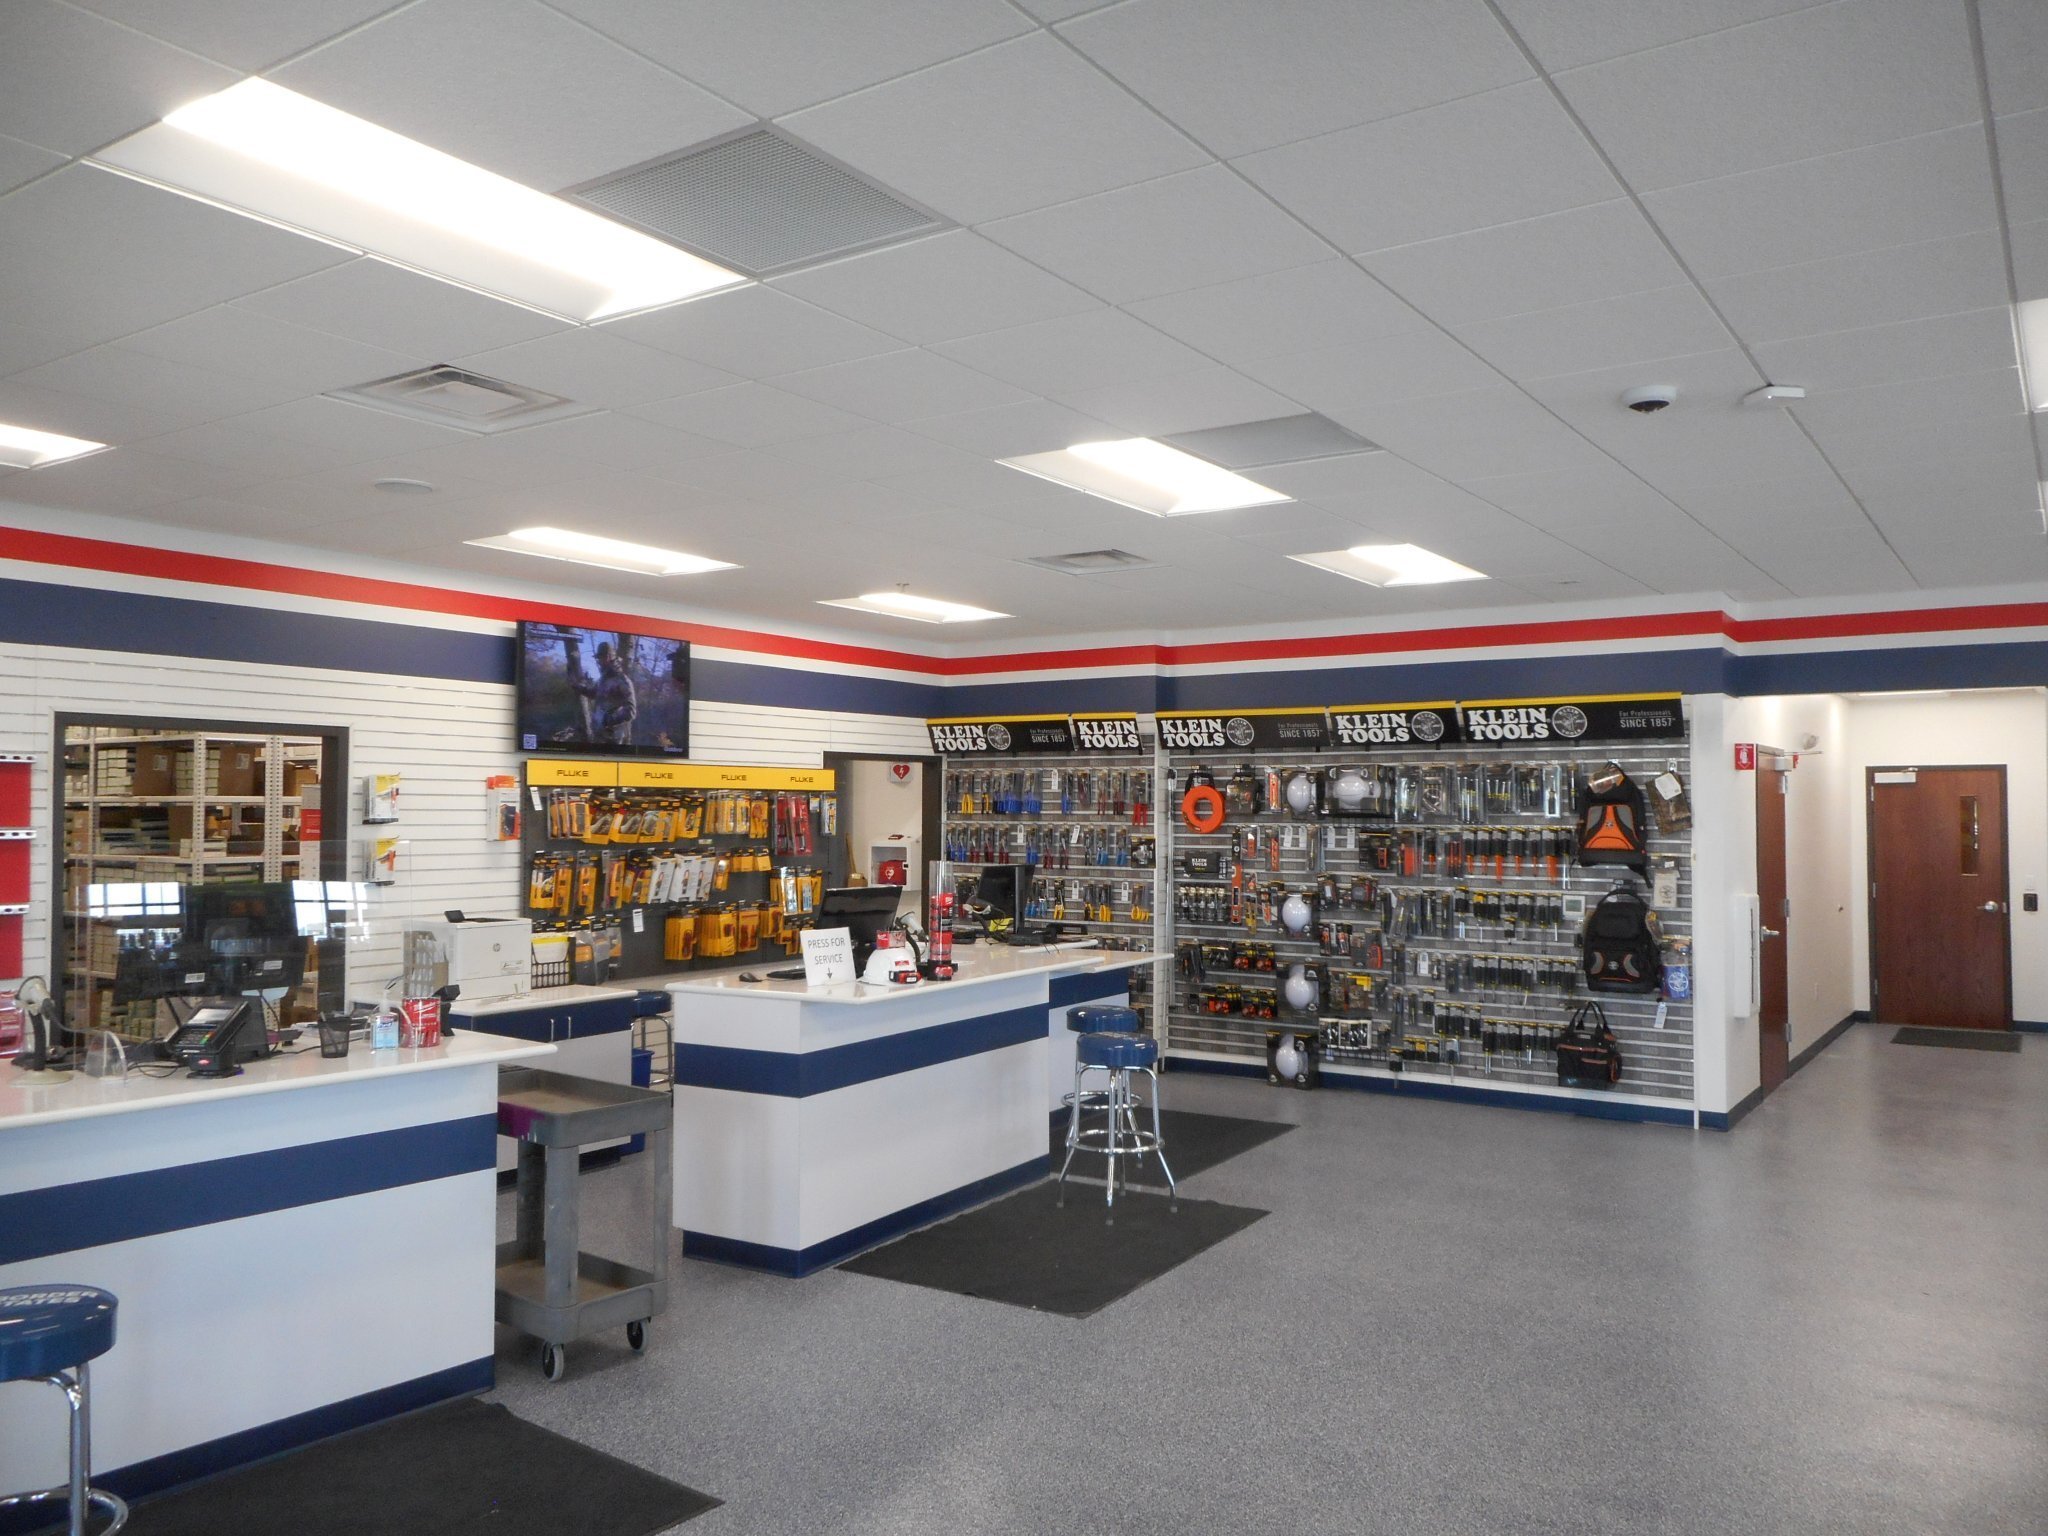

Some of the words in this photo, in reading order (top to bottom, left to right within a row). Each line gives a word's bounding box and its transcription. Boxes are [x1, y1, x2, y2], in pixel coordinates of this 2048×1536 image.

[1335, 713, 1407, 729] KLEIN
[1467, 707, 1547, 725] KLEIN
[1620, 718, 1647, 729] SINCE
[1650, 717, 1673, 728] 1857
[931, 725, 984, 739] KLEIN
[1078, 721, 1136, 735] KLEIN
[1160, 719, 1222, 734] KLEIN
[1279, 729, 1300, 738] SINCE
[1302, 729, 1320, 738] 1857
[1470, 723, 1550, 740] TOOLS
[1031, 735, 1049, 743] SINCE
[1081, 733, 1139, 748] TOOLS
[1163, 732, 1225, 747] TOOLS
[1337, 727, 1410, 743] TOOLS
[935, 737, 987, 751] TOOLS
[557, 769, 589, 777] FLUKE
[645, 772, 673, 780] FLUKE
[721, 774, 747, 782] FLUKE
[808, 939, 829, 949] PRESS
[831, 937, 845, 947] FOR
[814, 953, 843, 964] SERVICE
[0, 1297, 81, 1307] TATES
